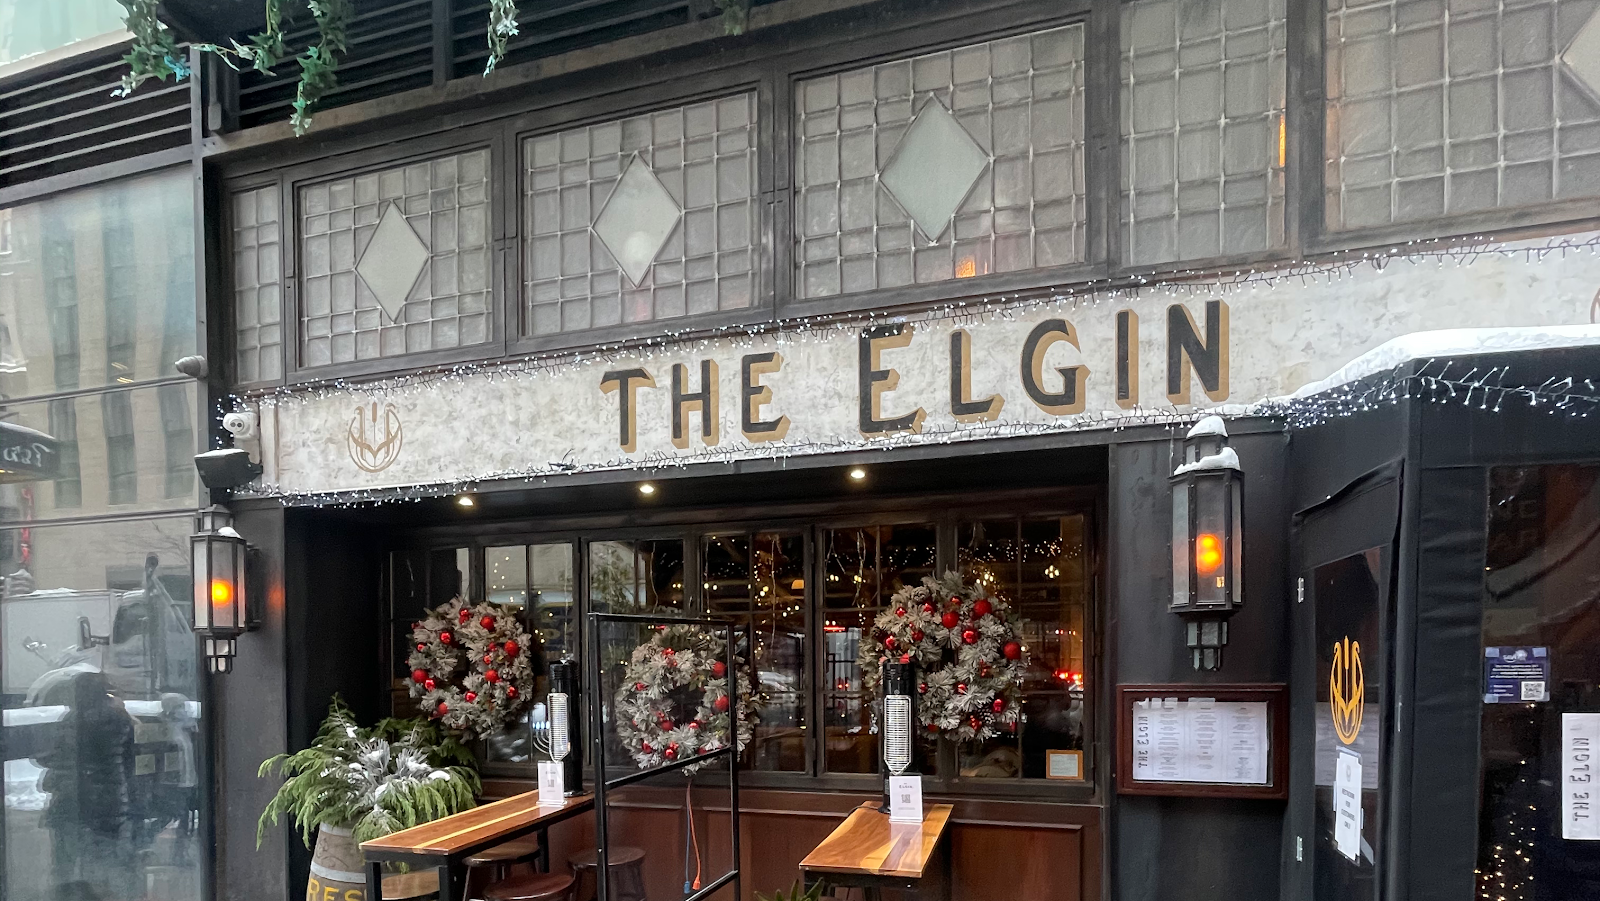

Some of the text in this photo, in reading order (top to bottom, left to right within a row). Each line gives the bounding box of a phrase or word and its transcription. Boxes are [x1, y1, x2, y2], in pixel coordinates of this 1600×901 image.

[600, 300, 1230, 453] THE ELGIN
[1137, 716, 1150, 769] THE ELGIN
[1569, 737, 1591, 822] THE ELGIN
[307, 878, 367, 901] RES
